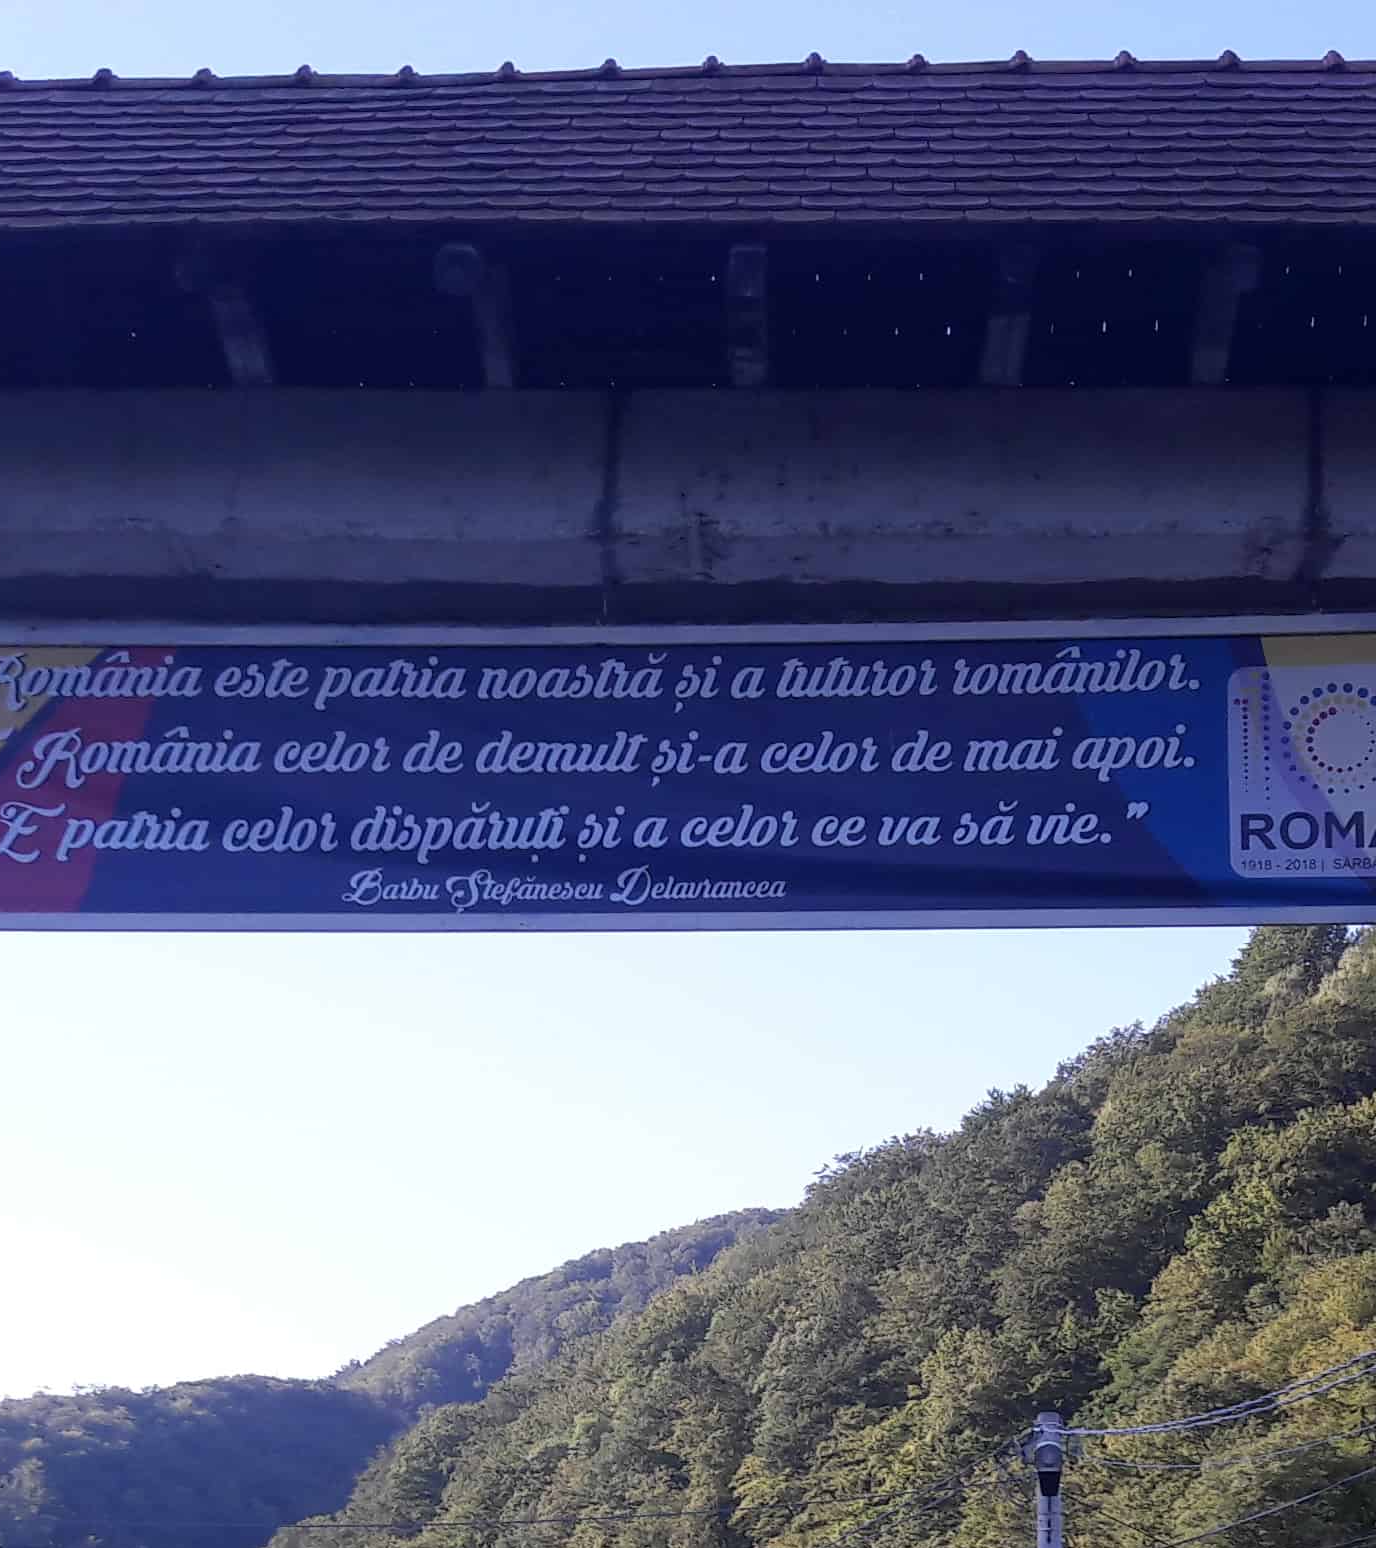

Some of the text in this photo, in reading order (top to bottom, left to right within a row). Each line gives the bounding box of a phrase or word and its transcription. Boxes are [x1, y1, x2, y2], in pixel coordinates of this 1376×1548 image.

[215, 657, 309, 698] este
[314, 656, 466, 711] patria
[477, 652, 667, 700] noastră
[674, 656, 722, 713] și
[730, 666, 765, 699] a
[776, 657, 937, 699] tuturor
[951, 646, 1201, 696] românilor.
[15, 726, 260, 789] România
[273, 730, 392, 774] celor
[401, 730, 464, 774] de
[474, 730, 649, 774] demult
[651, 730, 750, 787] și-a
[760, 730, 880, 774] celor
[890, 729, 954, 774] de
[962, 726, 1065, 772] mai
[1071, 723, 1196, 783] apoi.
[57, 806, 210, 861] patria
[223, 806, 338, 853] celor
[349, 801, 571, 865] dispăruți
[577, 805, 626, 863] și
[632, 813, 669, 849] a
[679, 804, 800, 849] celor
[810, 813, 867, 848] ce
[877, 812, 942, 848] va
[952, 800, 1019, 848] să
[1241, 859, 1273, 872] 1918
[1285, 858, 1317, 871] 2018
[342, 865, 787, 913] Barbu Ștefănescu Delavrancea
